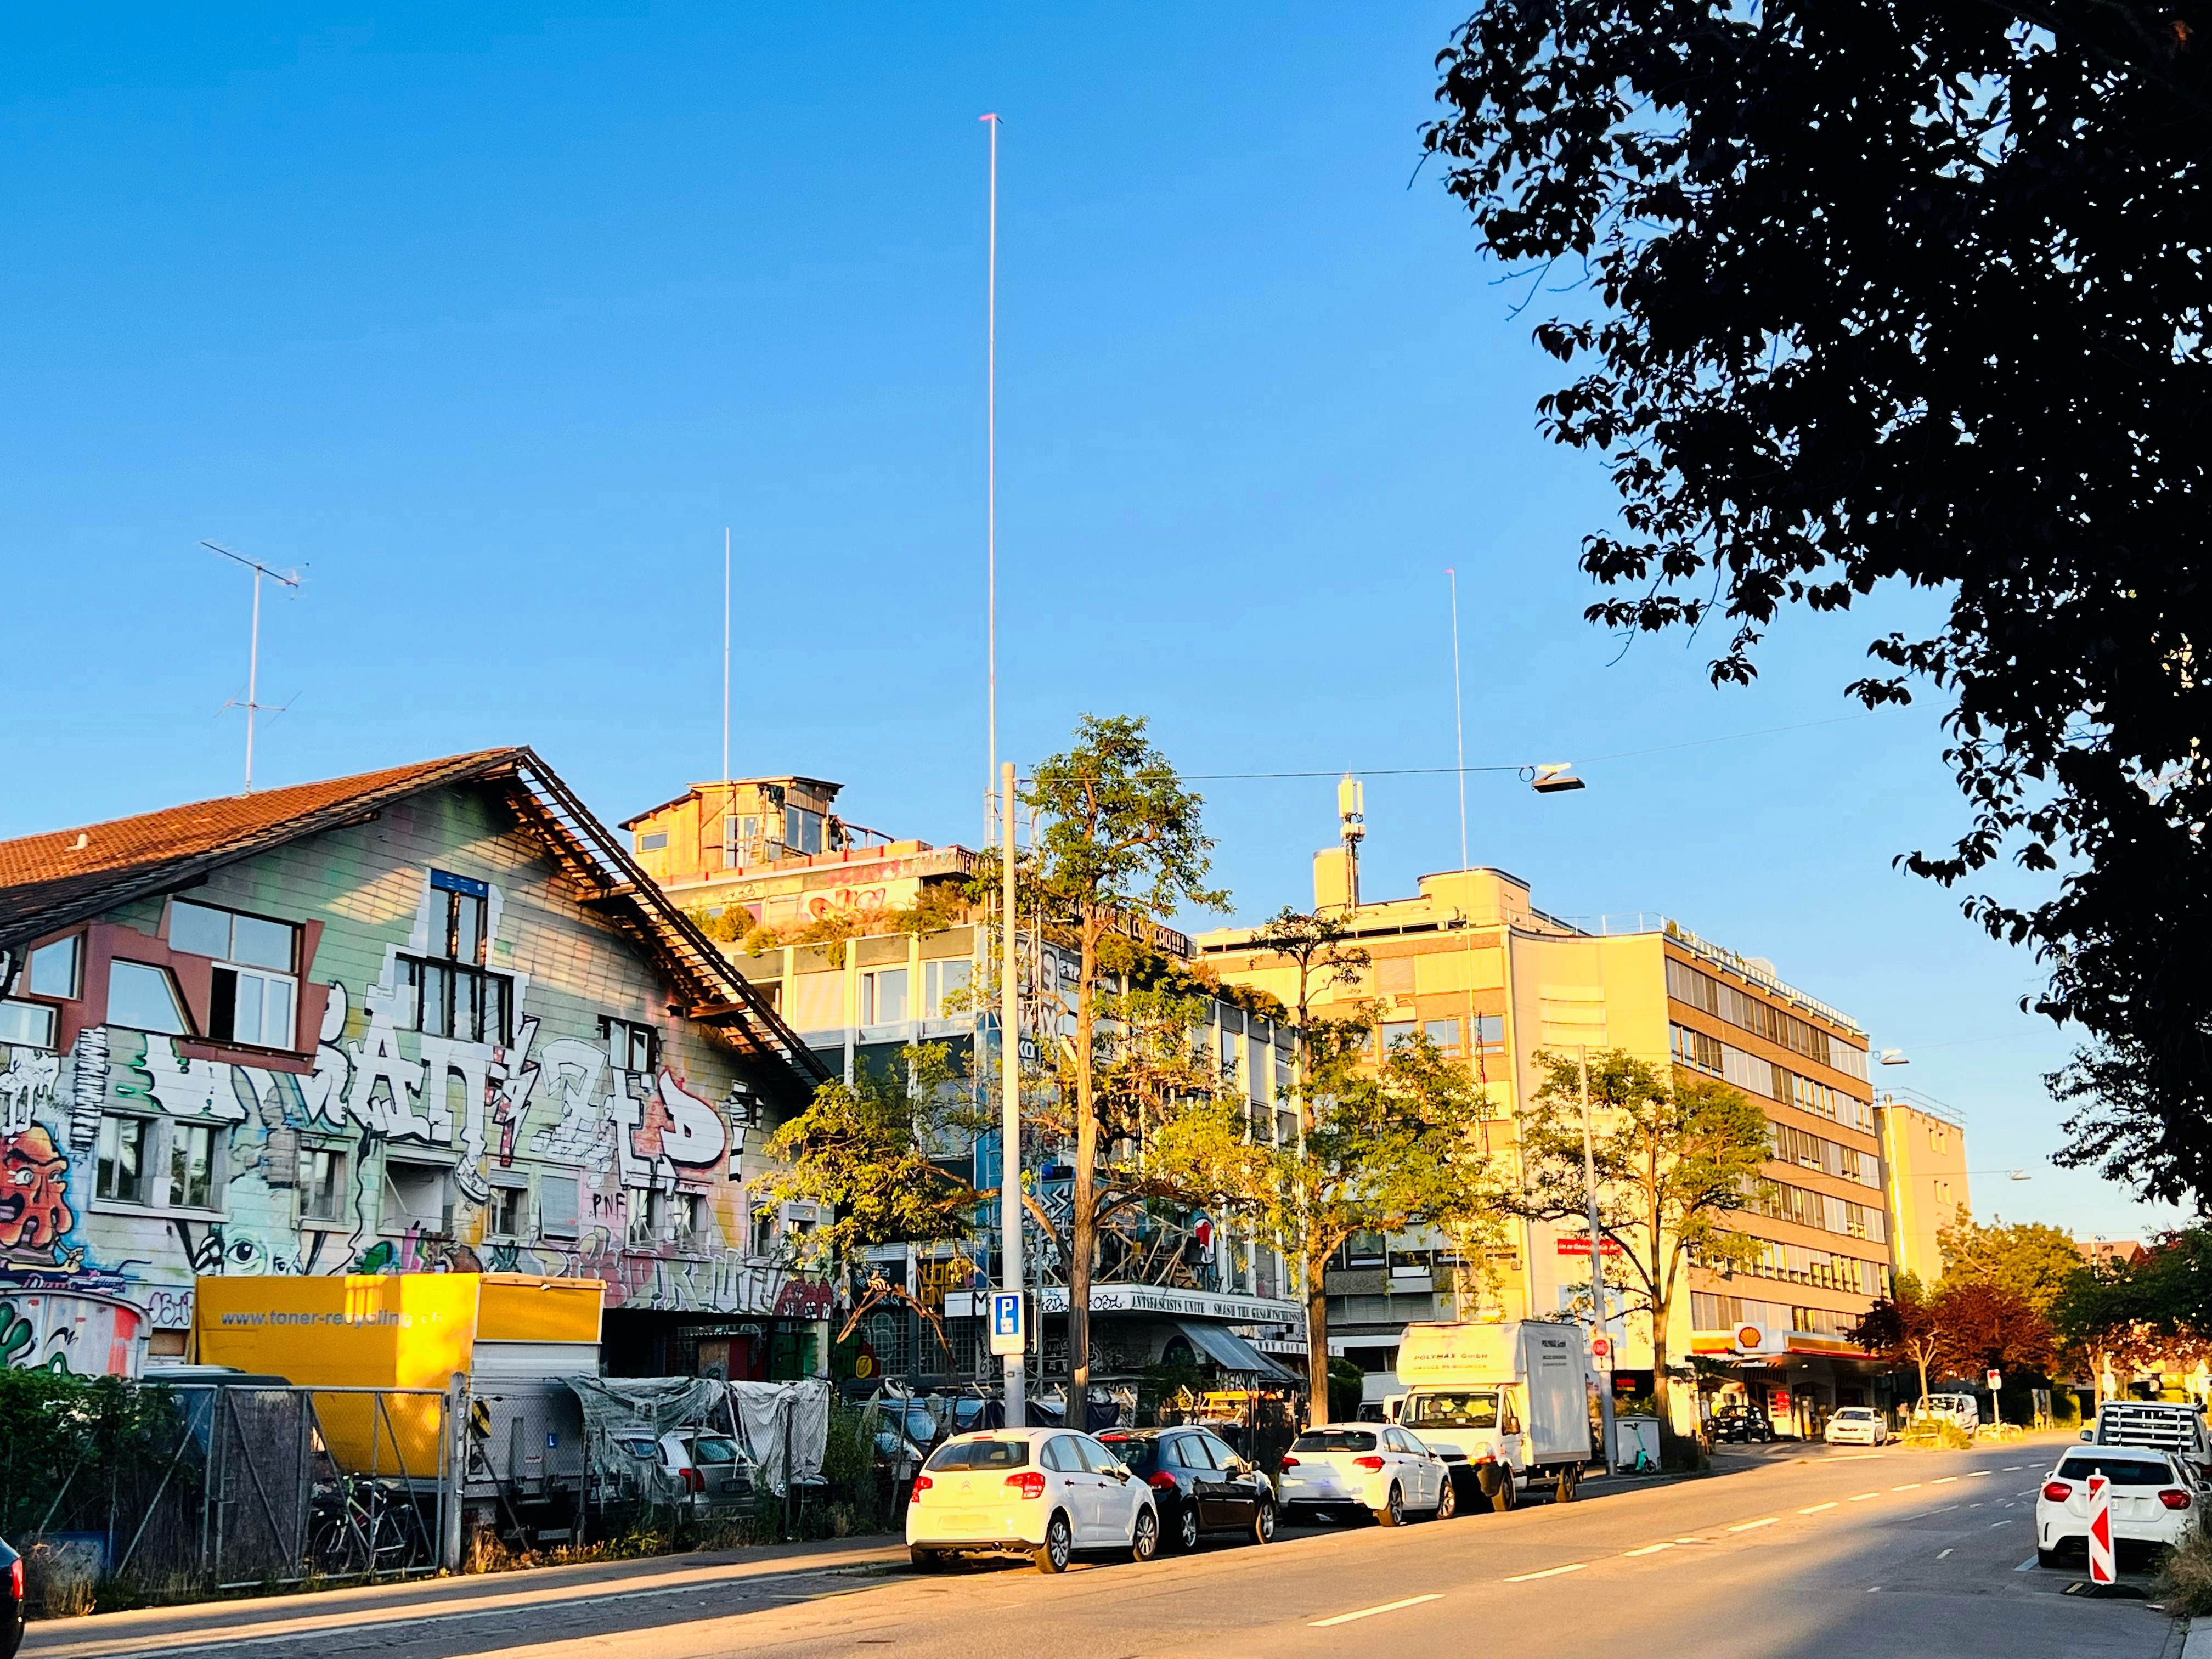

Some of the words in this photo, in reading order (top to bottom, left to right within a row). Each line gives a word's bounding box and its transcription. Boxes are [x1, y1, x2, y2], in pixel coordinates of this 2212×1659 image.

[593, 1193, 625, 1220] PNF
[1002, 1299, 1013, 1318] P
[1184, 1300, 1205, 1313] UNITE
